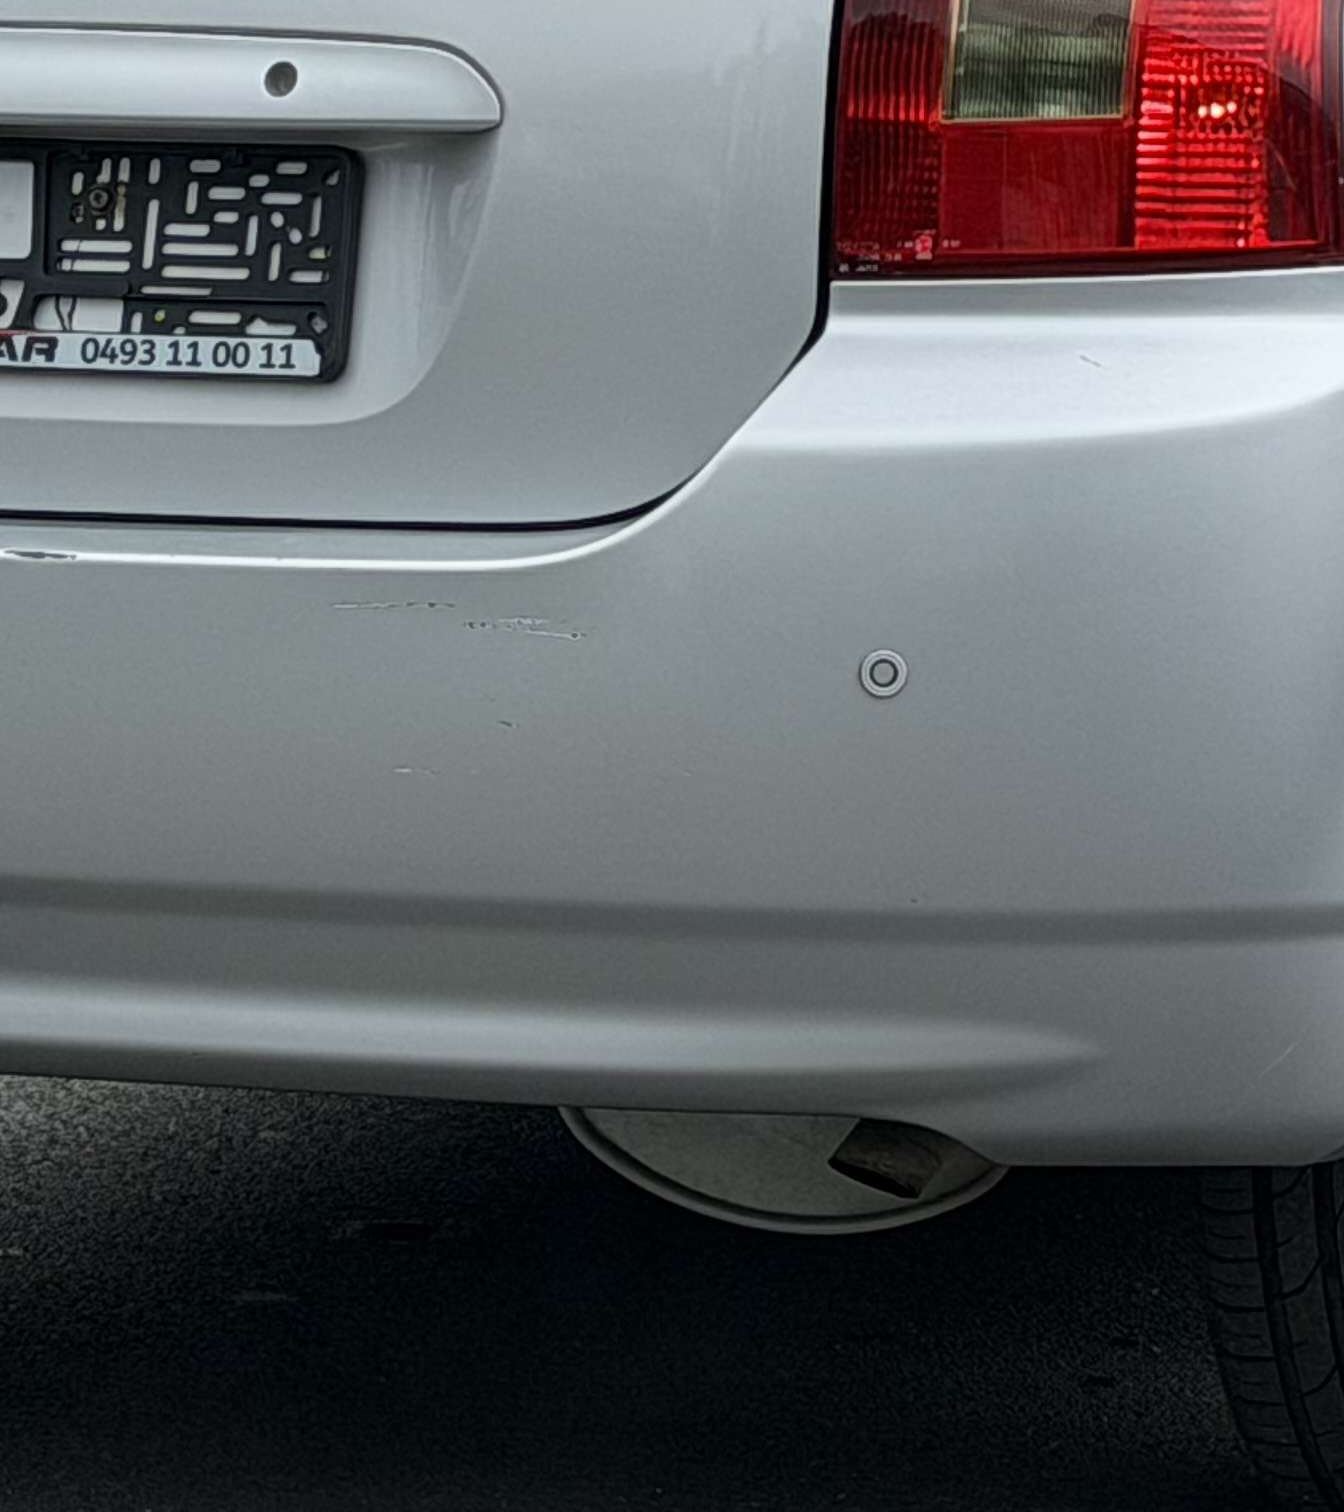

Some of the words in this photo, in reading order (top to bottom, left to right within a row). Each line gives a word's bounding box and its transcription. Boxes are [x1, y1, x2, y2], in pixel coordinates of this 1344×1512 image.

[80, 337, 156, 365] 0493
[165, 340, 203, 367] 11
[212, 341, 250, 368] 00
[258, 343, 297, 369] 11
